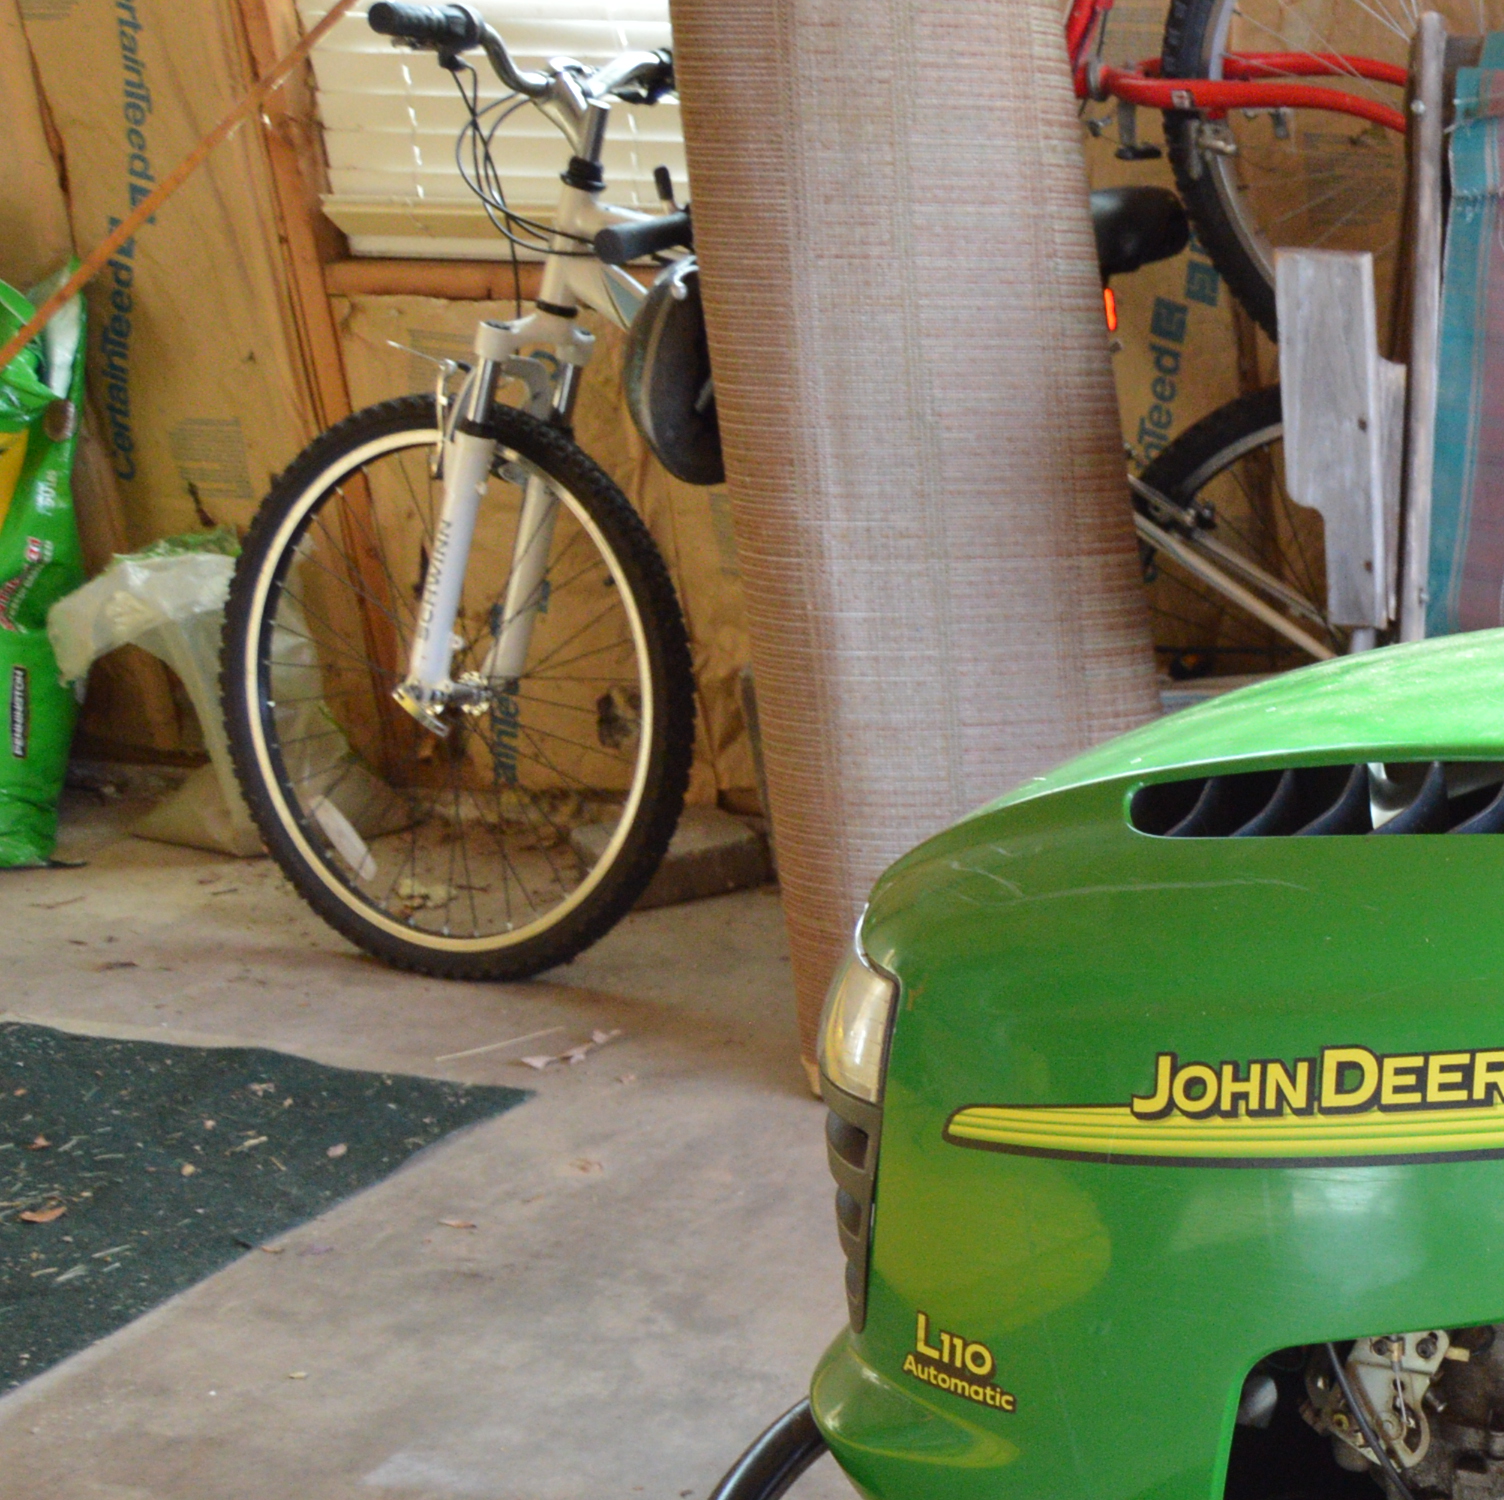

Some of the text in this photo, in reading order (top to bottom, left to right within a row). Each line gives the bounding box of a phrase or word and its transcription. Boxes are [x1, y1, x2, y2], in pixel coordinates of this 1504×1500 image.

[116, 0, 156, 183] rtainTeed
[100, 258, 137, 481] CertainTeed
[419, 519, 453, 642] SCHWINN
[13, 669, 25, 757] PENNINGTON
[1130, 1052, 1313, 1117] JOHN
[903, 1353, 1015, 1411] Automatic
[916, 1311, 993, 1376] L110
